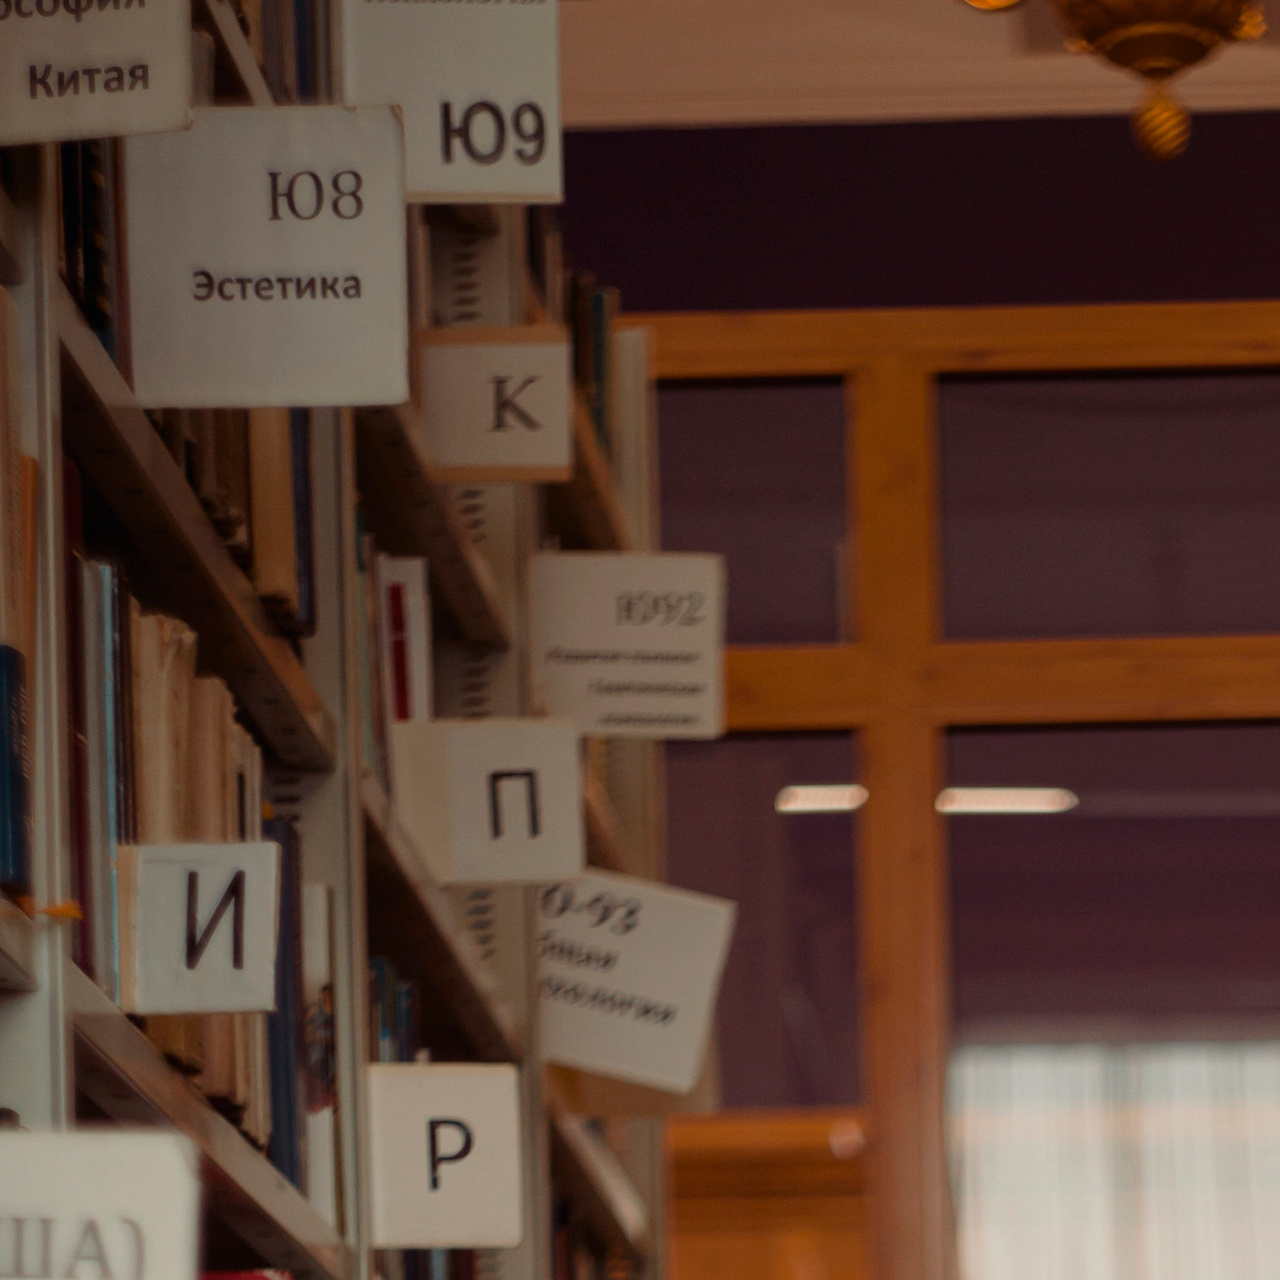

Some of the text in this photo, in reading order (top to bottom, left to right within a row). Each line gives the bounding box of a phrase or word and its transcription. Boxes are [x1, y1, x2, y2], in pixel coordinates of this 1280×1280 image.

[28, 63, 149, 100] Китая
[440, 100, 546, 165] Ю9
[267, 169, 364, 221] Ю8
[192, 268, 362, 302] Эстетика
[490, 375, 542, 433] К
[486, 768, 540, 840] П
[184, 870, 246, 970] И
[427, 1118, 474, 1191] Р
